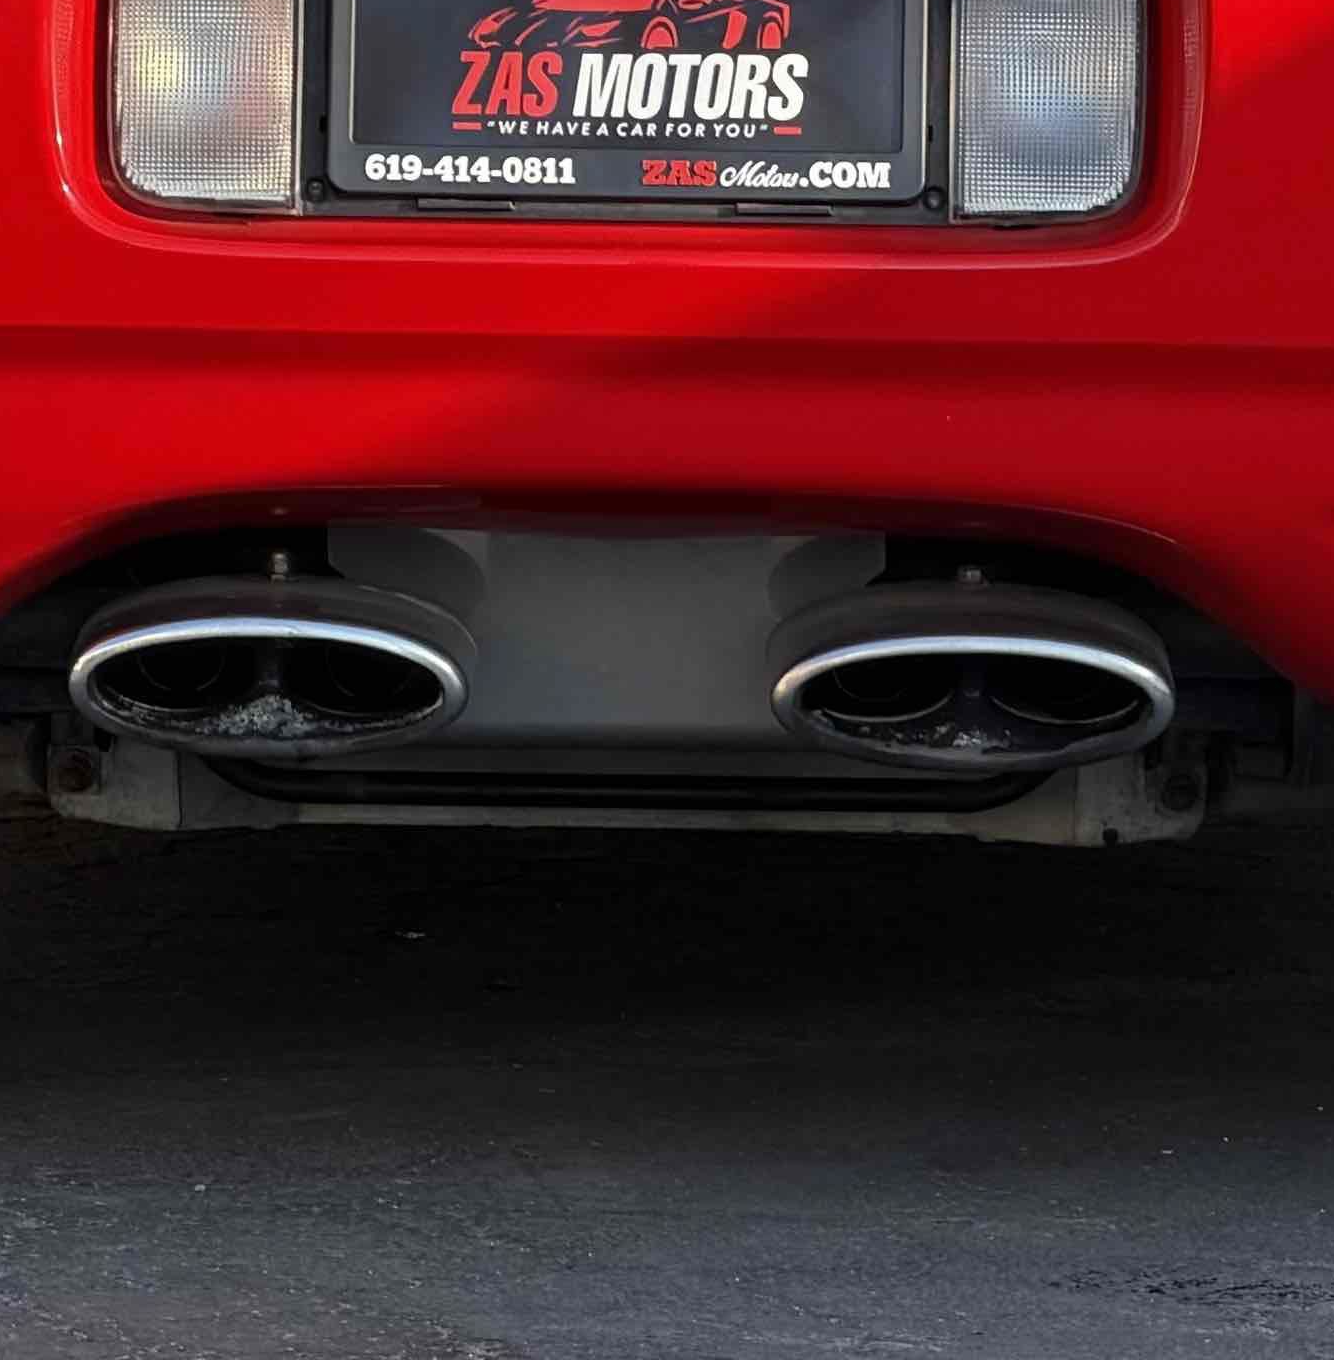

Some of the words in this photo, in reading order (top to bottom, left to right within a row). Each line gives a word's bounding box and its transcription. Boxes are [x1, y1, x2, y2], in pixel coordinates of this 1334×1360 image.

[452, 51, 564, 116] ZAS
[571, 52, 809, 122] MOTORS
[536, 121, 593, 137] HAVE
[596, 122, 610, 137] A
[616, 122, 658, 137] CAR
[665, 123, 706, 138] FOR
[365, 154, 576, 186] 619-414-0811
